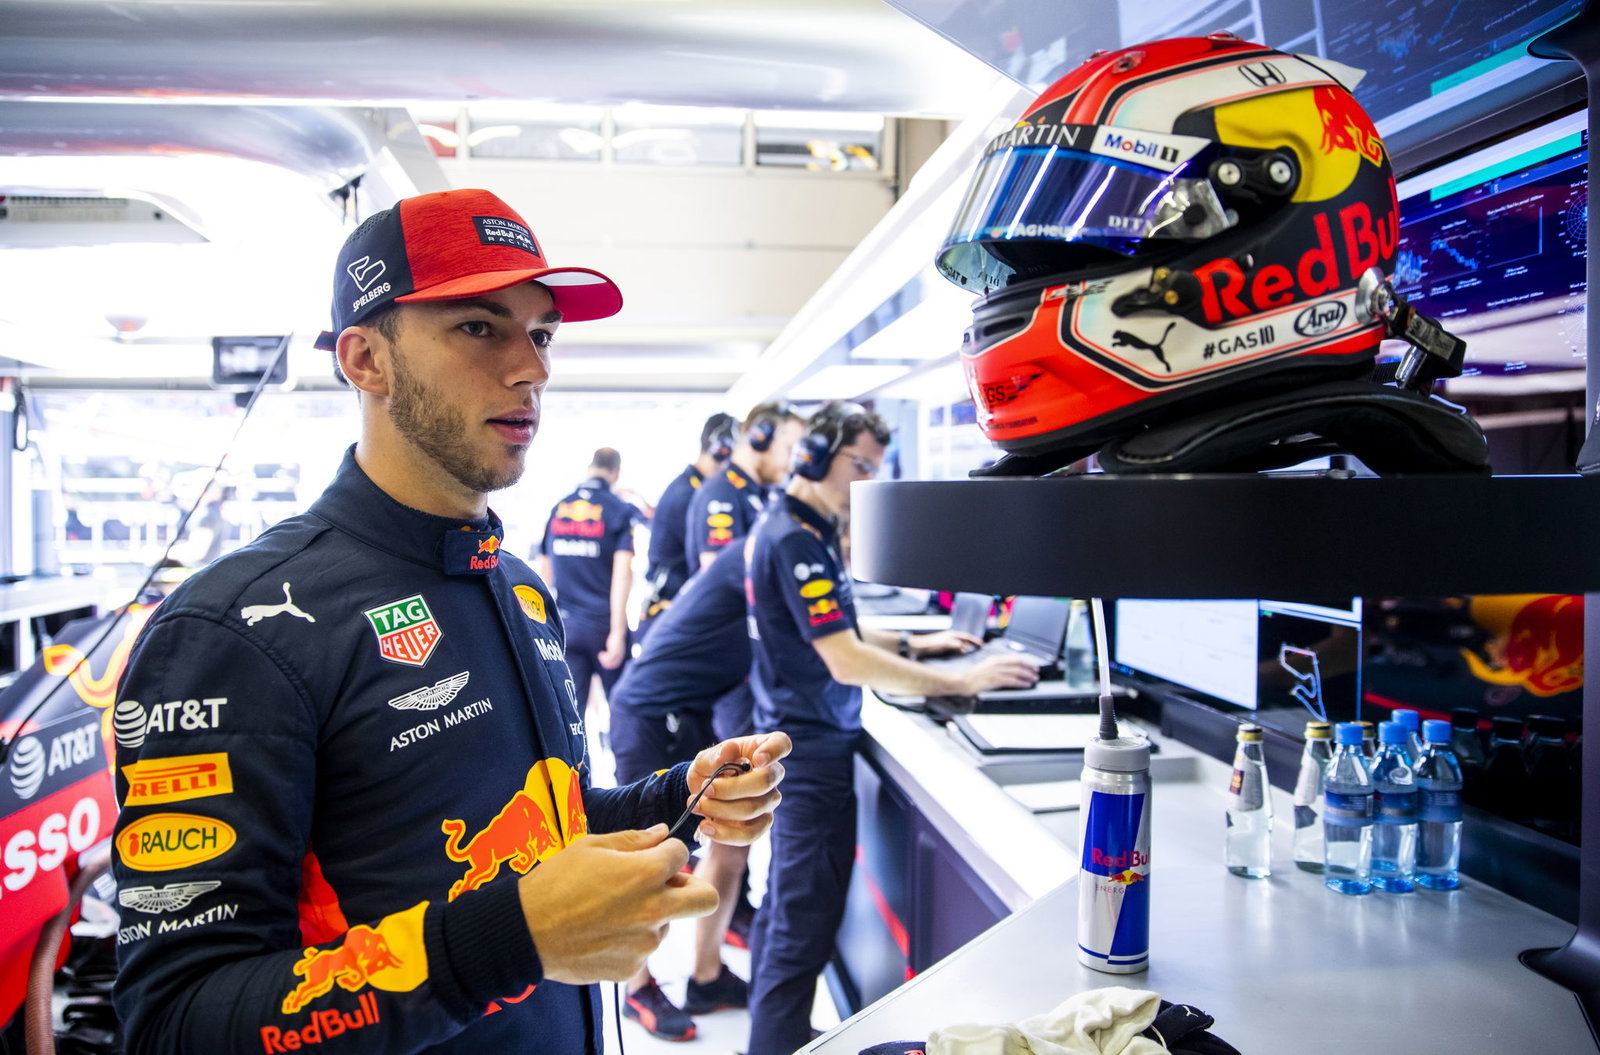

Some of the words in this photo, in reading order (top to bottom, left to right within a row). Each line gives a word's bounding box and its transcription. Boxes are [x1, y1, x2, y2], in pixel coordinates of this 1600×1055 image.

[1104, 133, 1159, 157] Mobil
[482, 218, 506, 226] ASTON
[487, 236, 536, 252] RACING
[352, 282, 391, 312] SPIELBERG
[373, 601, 423, 631] TAG
[382, 623, 436, 660] HEUER
[146, 697, 228, 735] AT&T
[390, 719, 441, 752] ASTON
[444, 698, 493, 729] MARTIN
[47, 723, 99, 776] AT&T
[129, 773, 217, 798] RELLI
[141, 826, 217, 854] RAUCH
[1095, 882, 1125, 895] ENERG
[118, 921, 152, 945] ASTON
[158, 904, 238, 934] MARTIN
